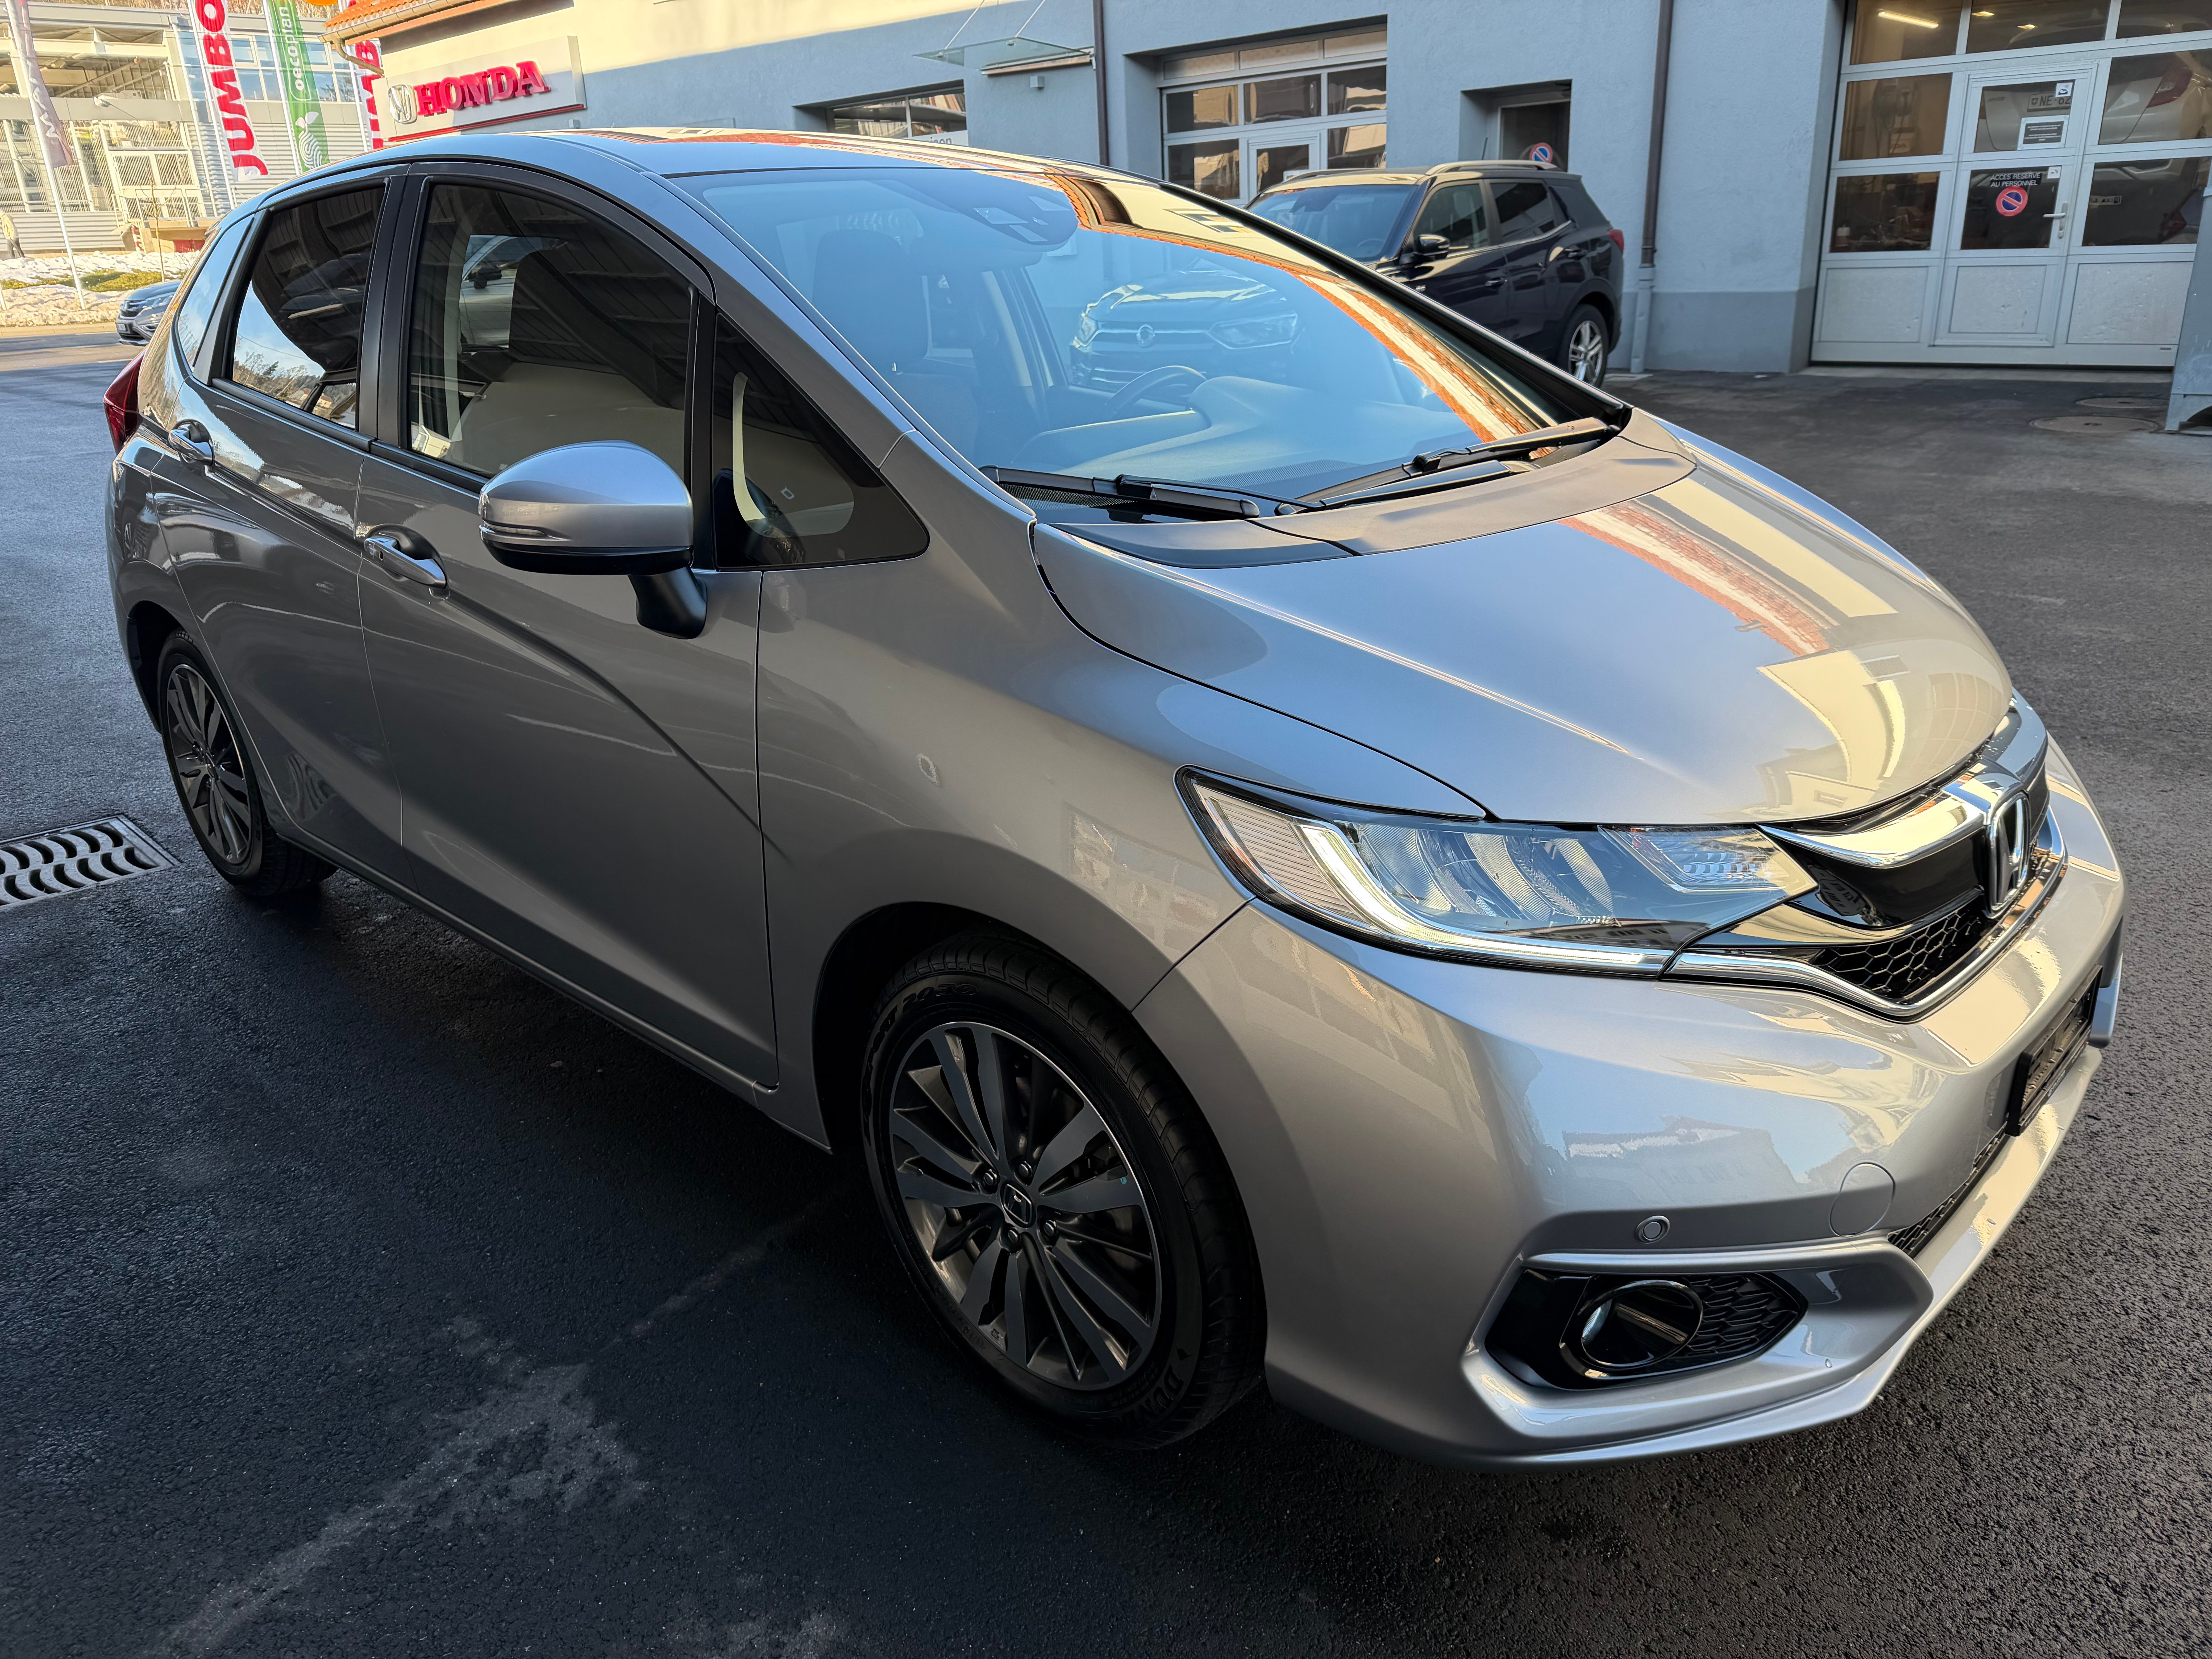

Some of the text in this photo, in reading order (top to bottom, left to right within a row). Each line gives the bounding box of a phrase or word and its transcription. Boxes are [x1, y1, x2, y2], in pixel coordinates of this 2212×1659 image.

[195, 0, 268, 175] JUMBO
[279, 7, 304, 91] oecoplan
[413, 61, 550, 116] HONDA
